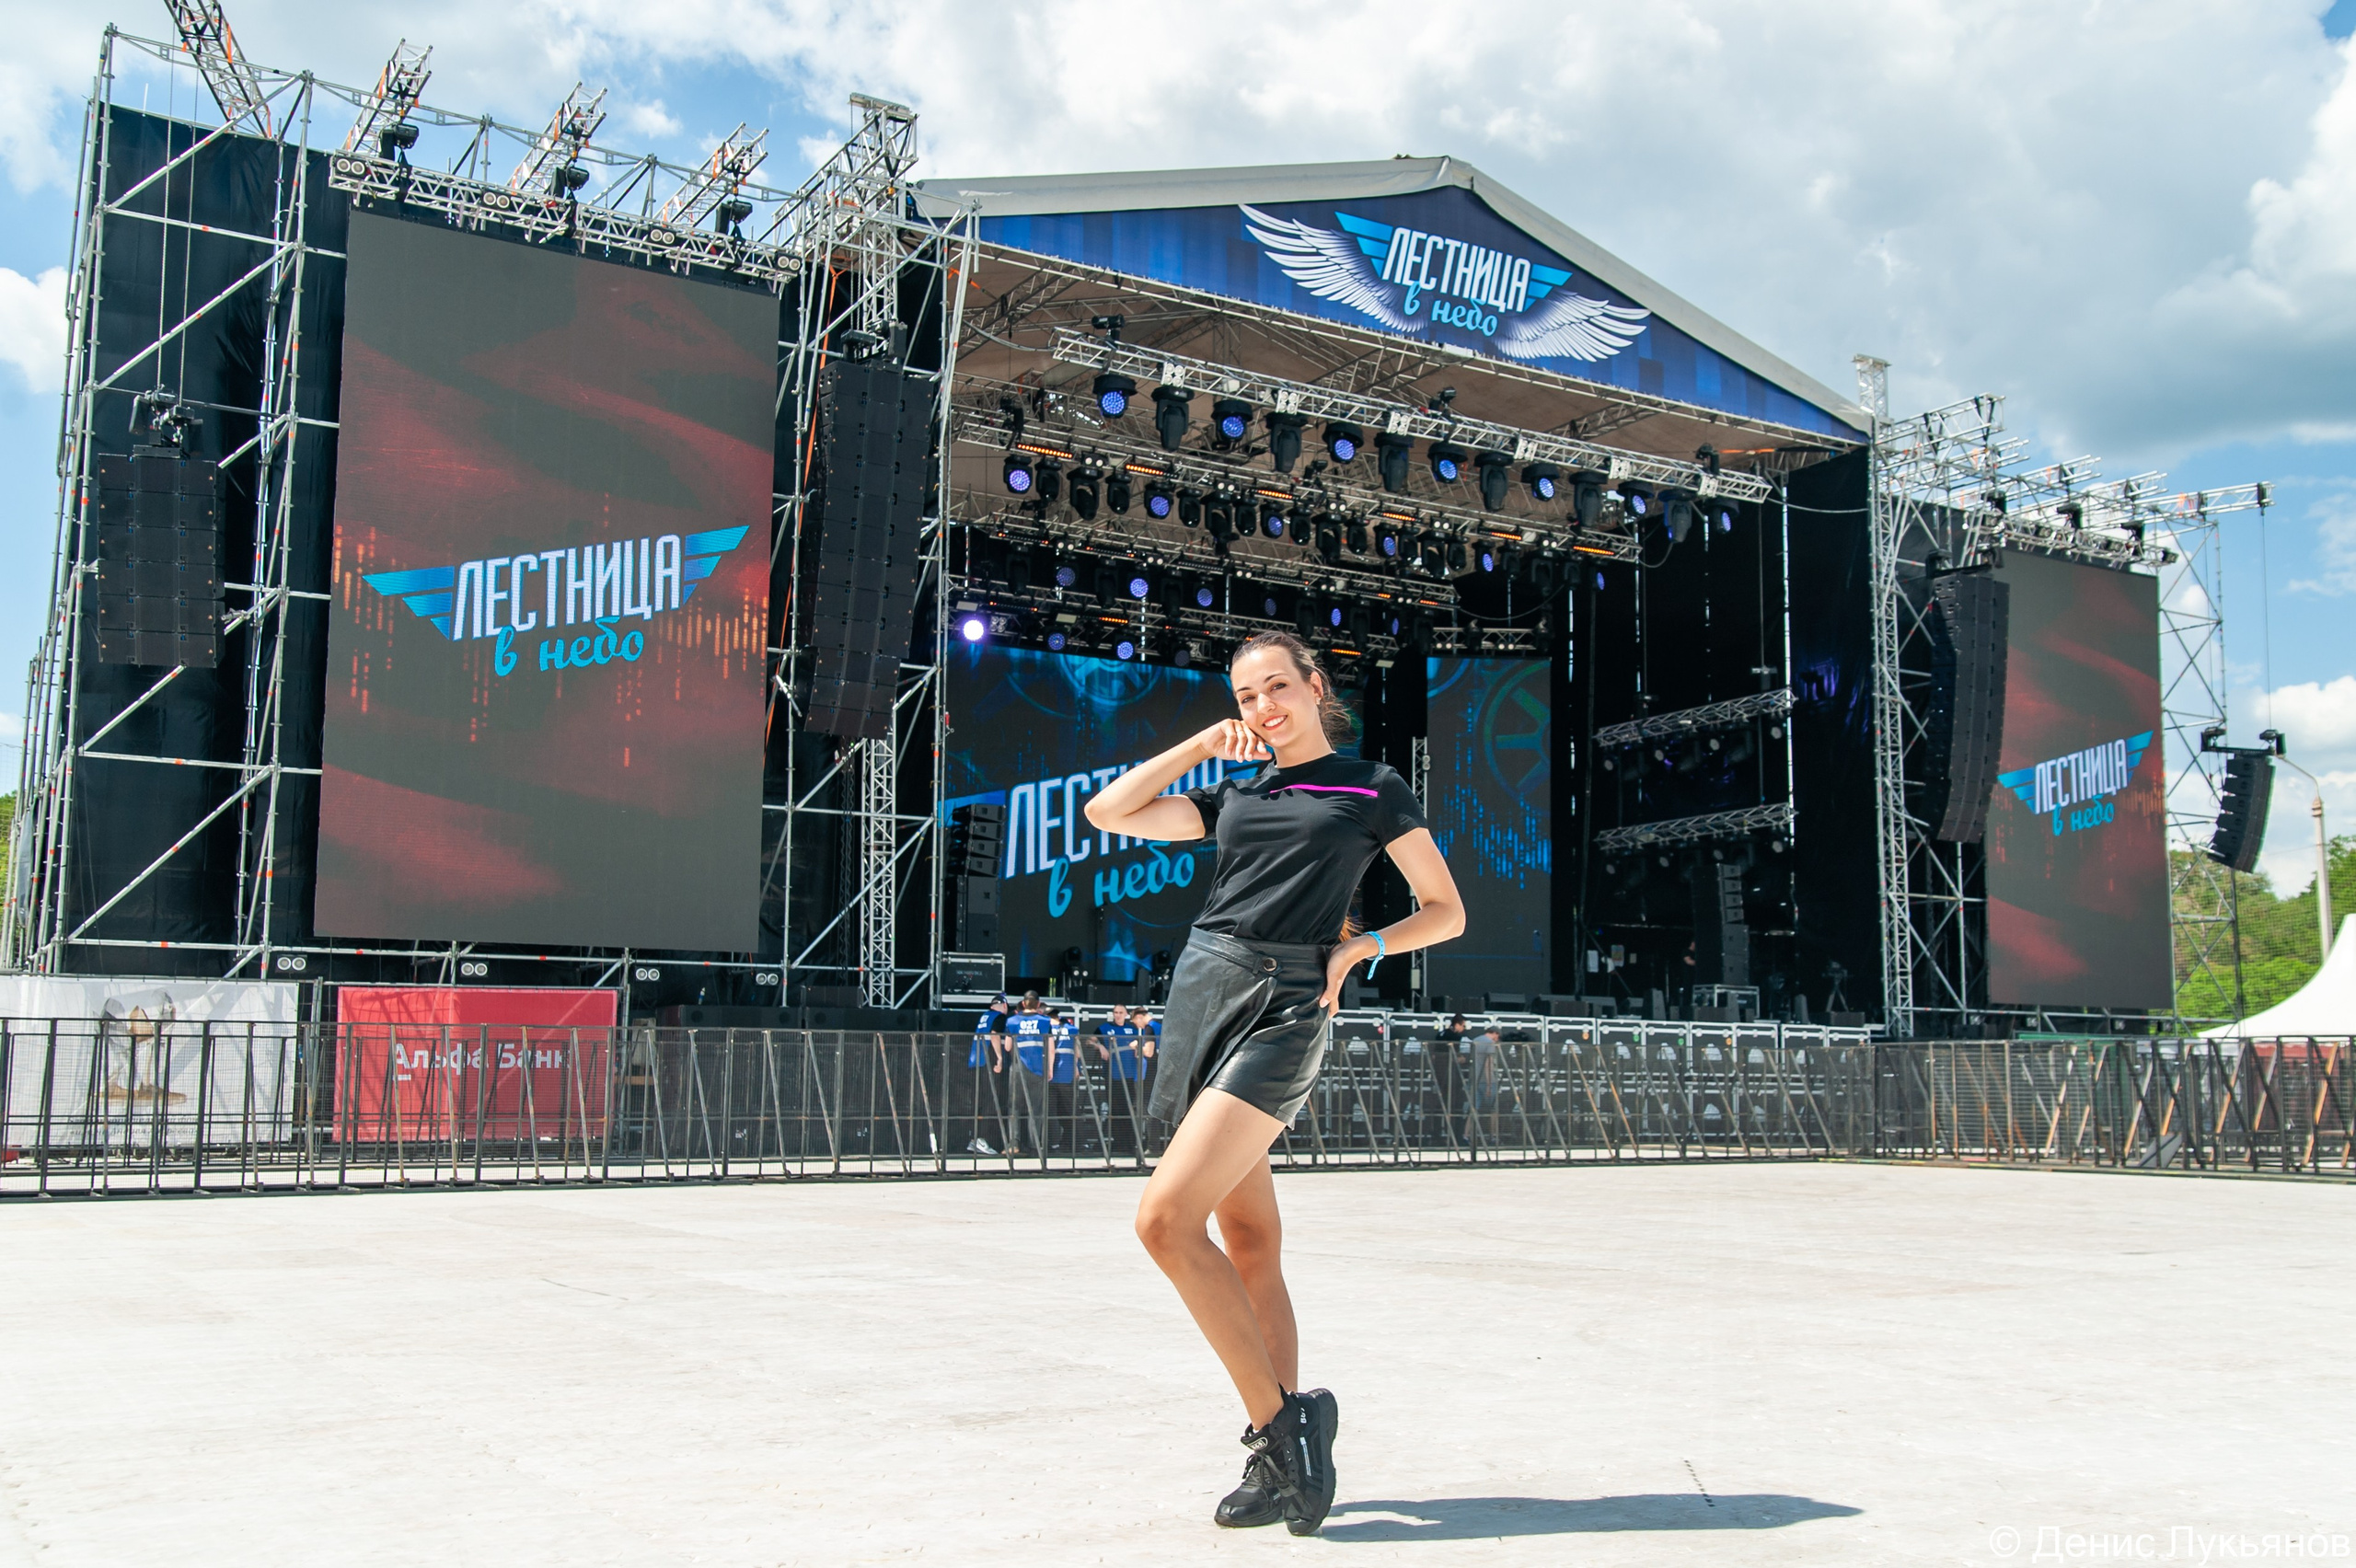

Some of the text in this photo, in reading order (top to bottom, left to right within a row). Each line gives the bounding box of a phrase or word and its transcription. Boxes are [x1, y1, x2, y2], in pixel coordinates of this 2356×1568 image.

[1381, 226, 1531, 314] ЛЕСТНИЦА
[1403, 281, 1498, 337] в небо
[453, 534, 681, 641] ЛЕСТНИЦА
[494, 616, 644, 676] в небо
[2035, 738, 2128, 814] ЛЕСТНИЦА
[2052, 792, 2115, 836] в небо
[1047, 839, 1195, 918] в небо
[1020, 1020, 1038, 1030] 027
